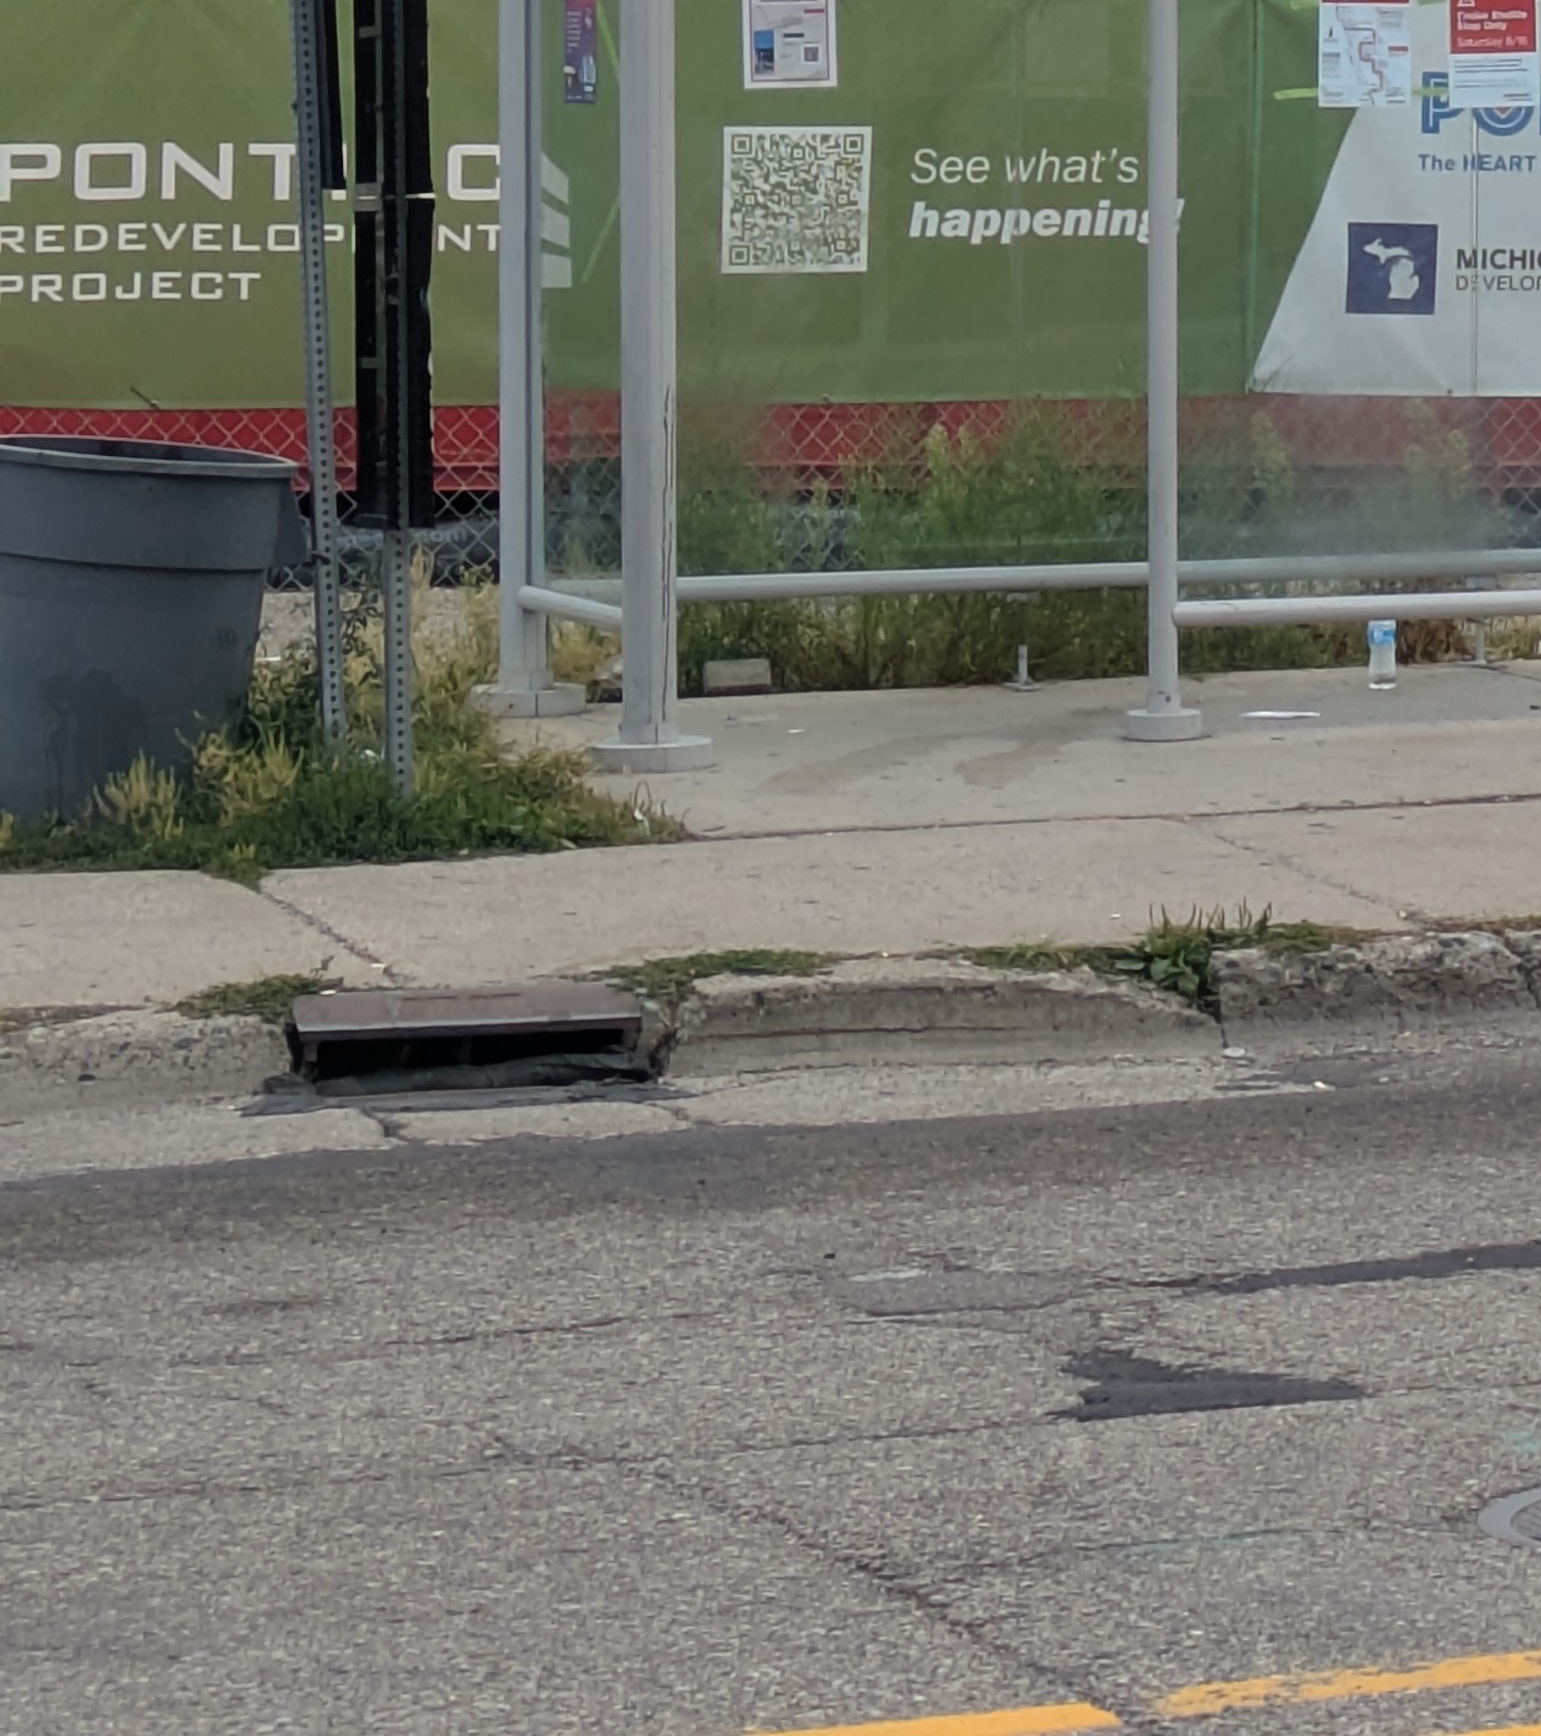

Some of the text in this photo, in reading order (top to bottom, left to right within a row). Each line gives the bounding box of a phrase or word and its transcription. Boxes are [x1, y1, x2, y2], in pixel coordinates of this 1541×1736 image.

[0, 141, 501, 202] PONTC
[910, 147, 1140, 184] See what's
[1418, 153, 1456, 173] The
[1463, 154, 1537, 173] HEART
[0, 221, 503, 254] REDEVELOPNT
[0, 271, 262, 302] PROJECT
